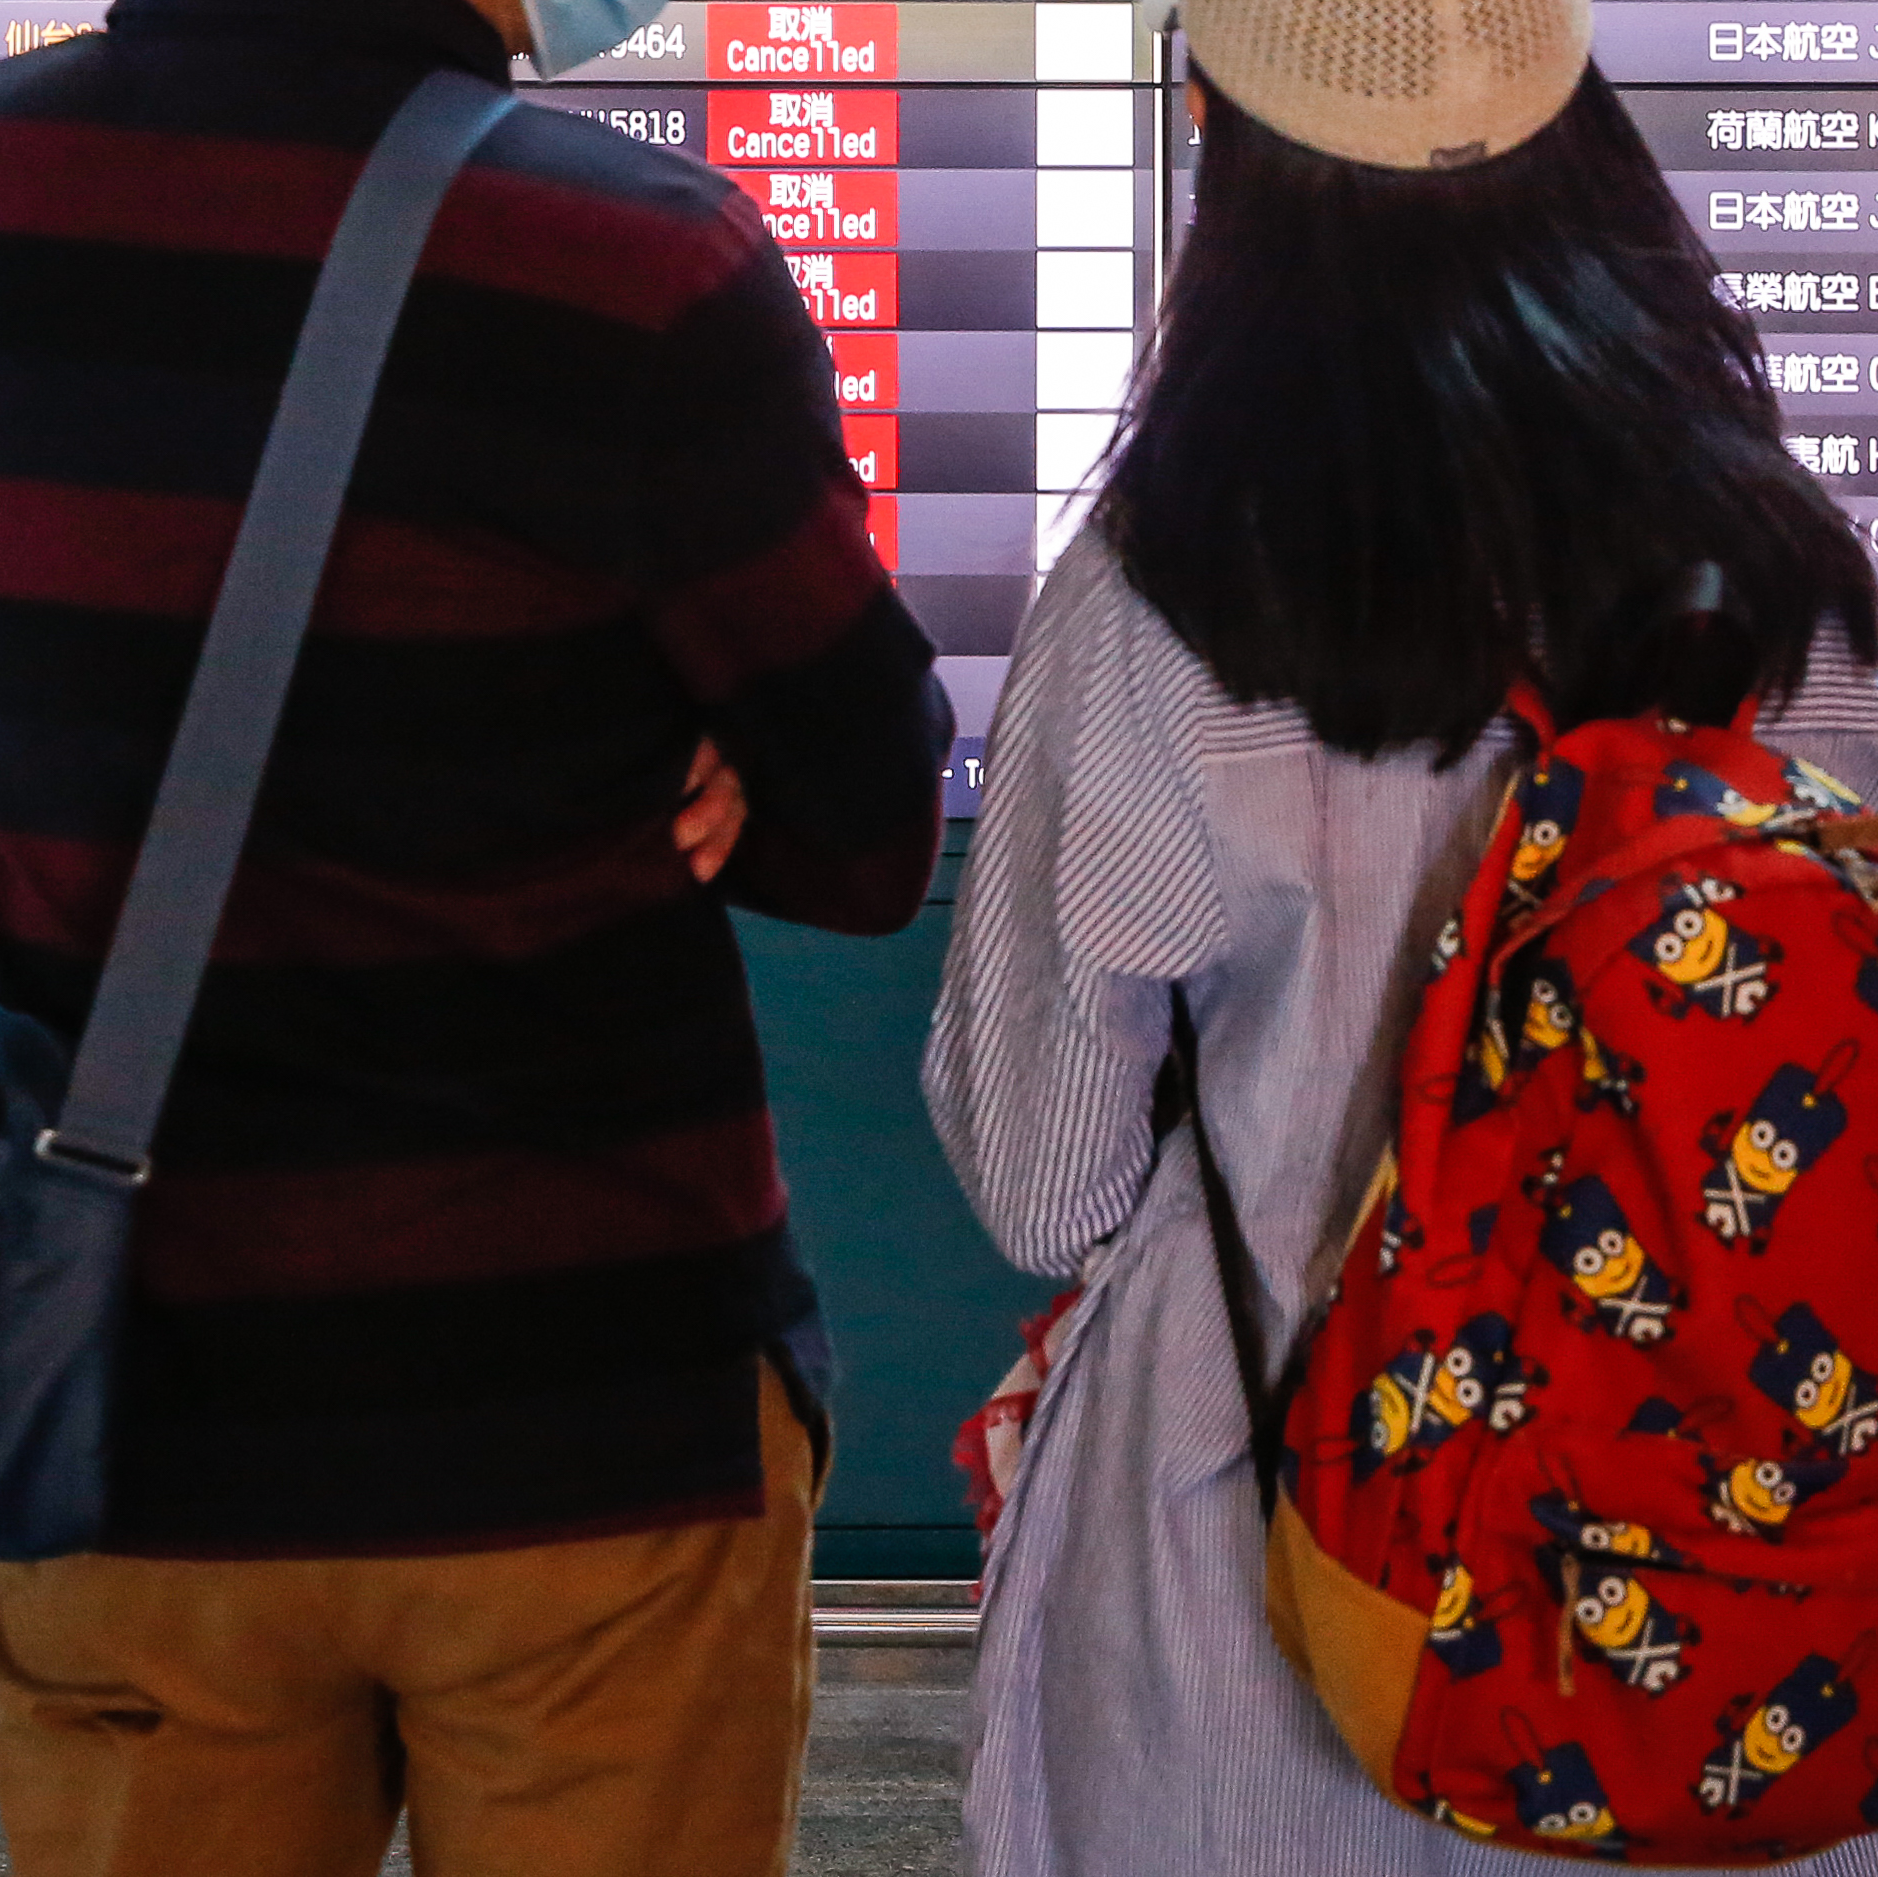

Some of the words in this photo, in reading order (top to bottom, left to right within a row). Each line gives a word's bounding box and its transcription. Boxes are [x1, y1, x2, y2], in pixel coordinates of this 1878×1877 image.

[768, 6, 833, 37] 取消
[1709, 21, 1858, 61] 日本航空
[727, 33, 875, 72] Cancelled
[1707, 110, 1859, 149] 荷蘭航空
[1710, 191, 1859, 230] 日本航空
